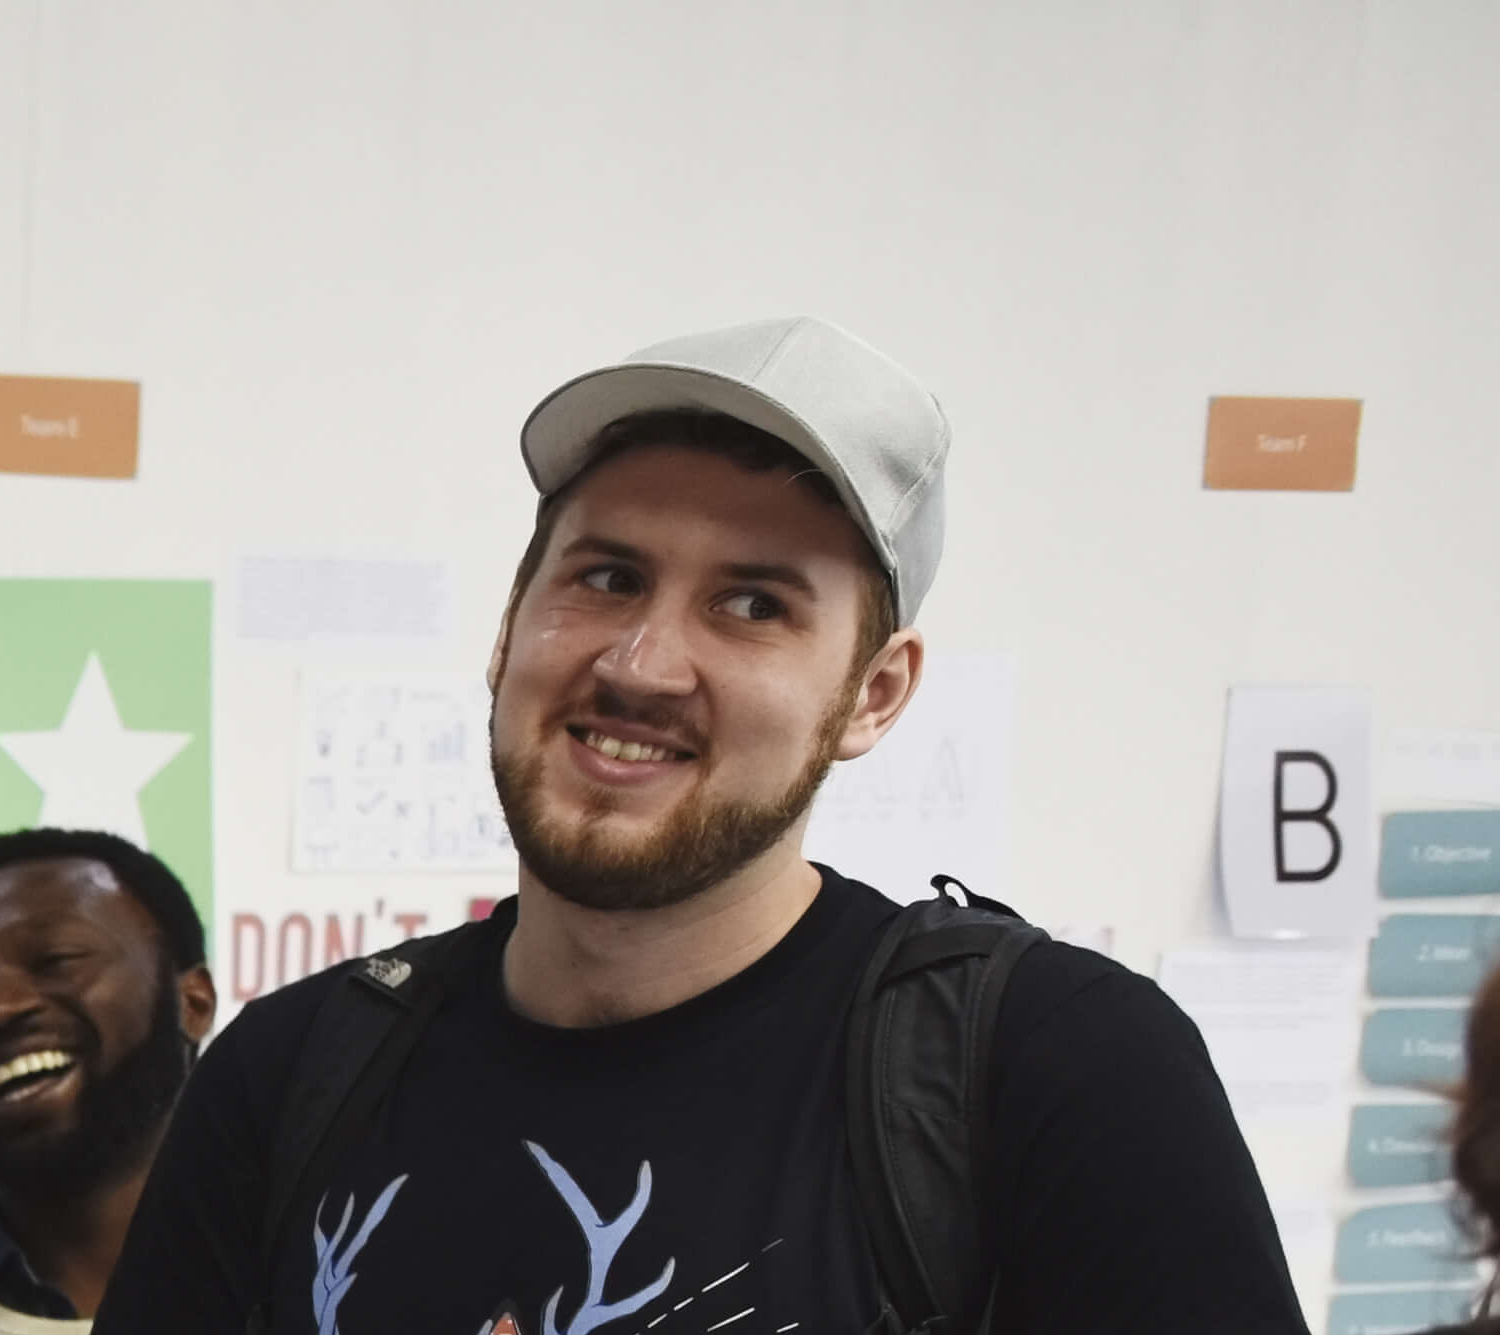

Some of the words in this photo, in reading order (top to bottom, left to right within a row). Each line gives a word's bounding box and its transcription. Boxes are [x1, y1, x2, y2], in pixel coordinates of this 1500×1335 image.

[20, 414, 62, 439] Team
[1257, 433, 1296, 454] Team
[1273, 751, 1343, 884] B
[231, 898, 428, 1001] DON'
